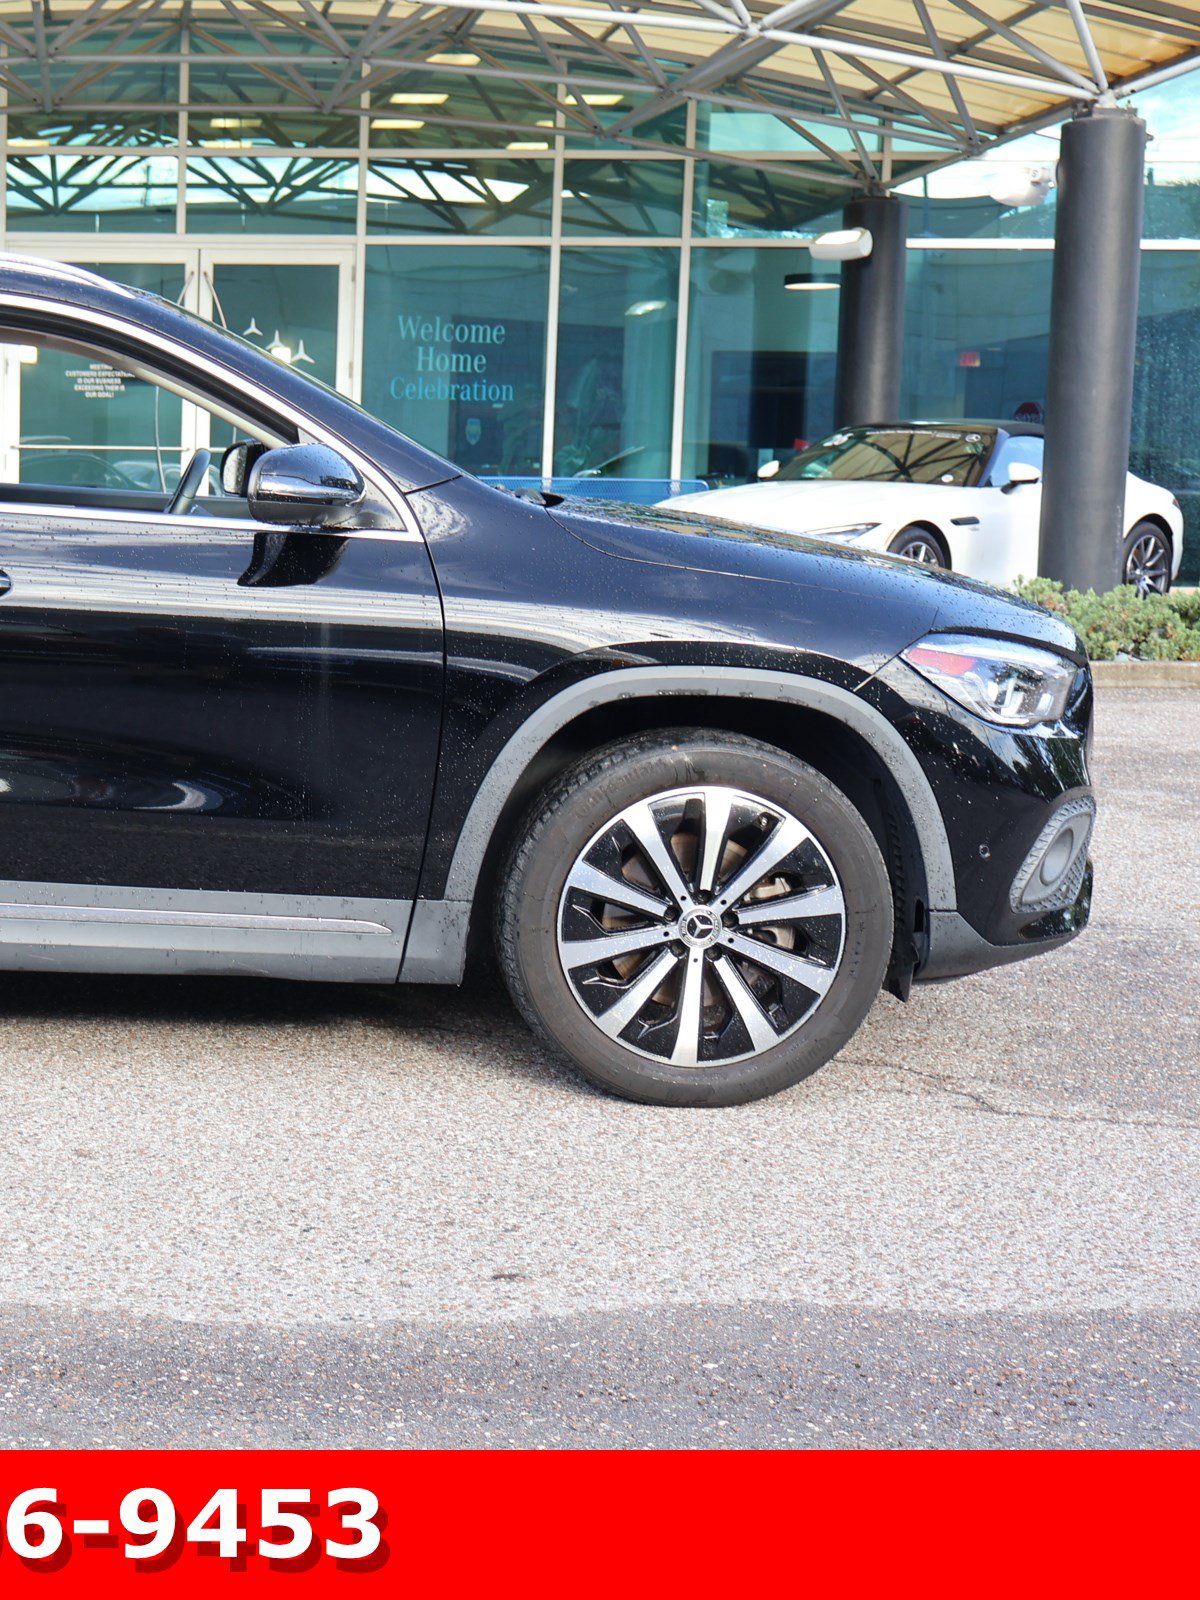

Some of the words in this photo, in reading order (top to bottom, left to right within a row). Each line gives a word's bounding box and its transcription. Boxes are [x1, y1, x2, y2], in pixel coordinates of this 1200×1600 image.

[398, 315, 505, 344] Welcome
[416, 346, 486, 373] Home
[390, 376, 514, 401] Celebration
